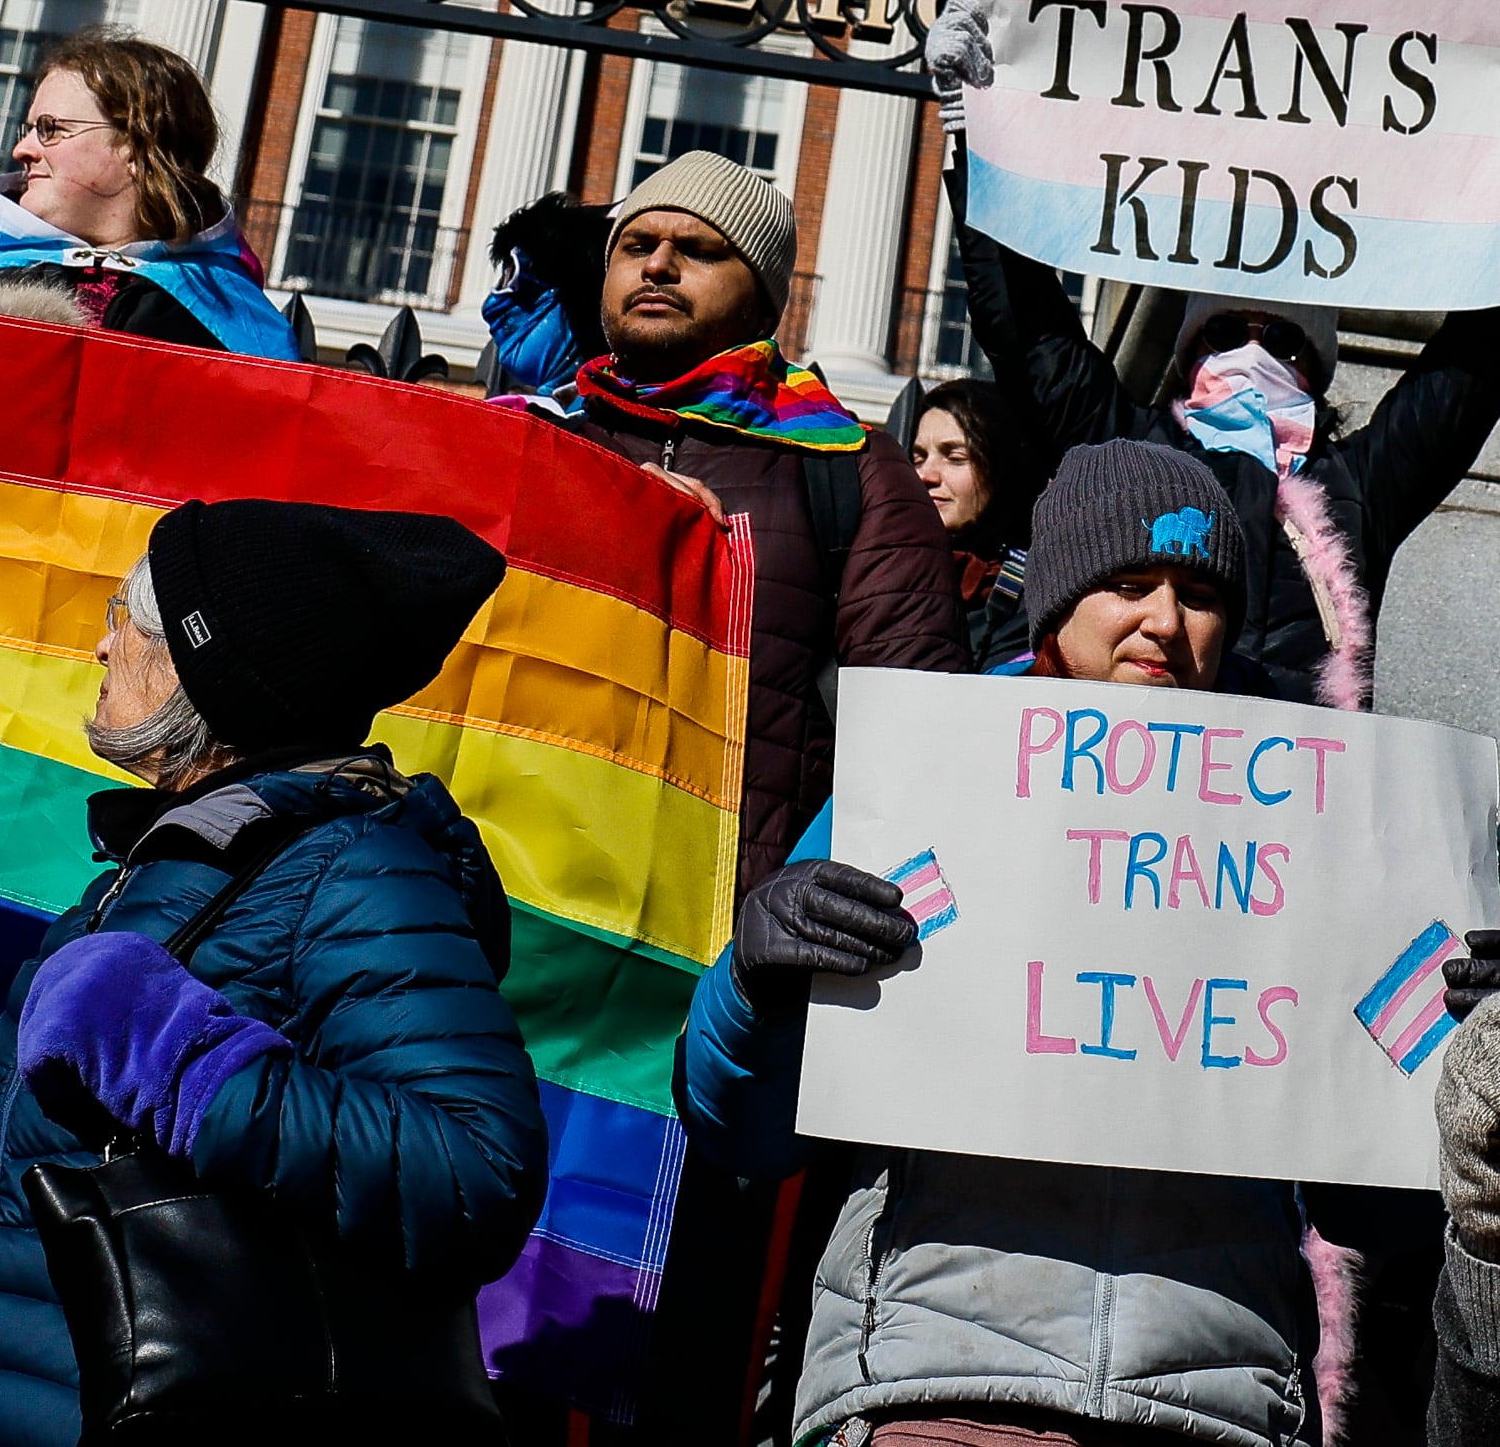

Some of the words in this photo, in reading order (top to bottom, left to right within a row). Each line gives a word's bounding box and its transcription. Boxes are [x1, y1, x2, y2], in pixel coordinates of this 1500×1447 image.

[1090, 153, 1358, 279] KIDS
[1015, 707, 1347, 814] PROTECT
[1066, 829, 1292, 916] TRANS
[1025, 960, 1299, 1069] LIVES
